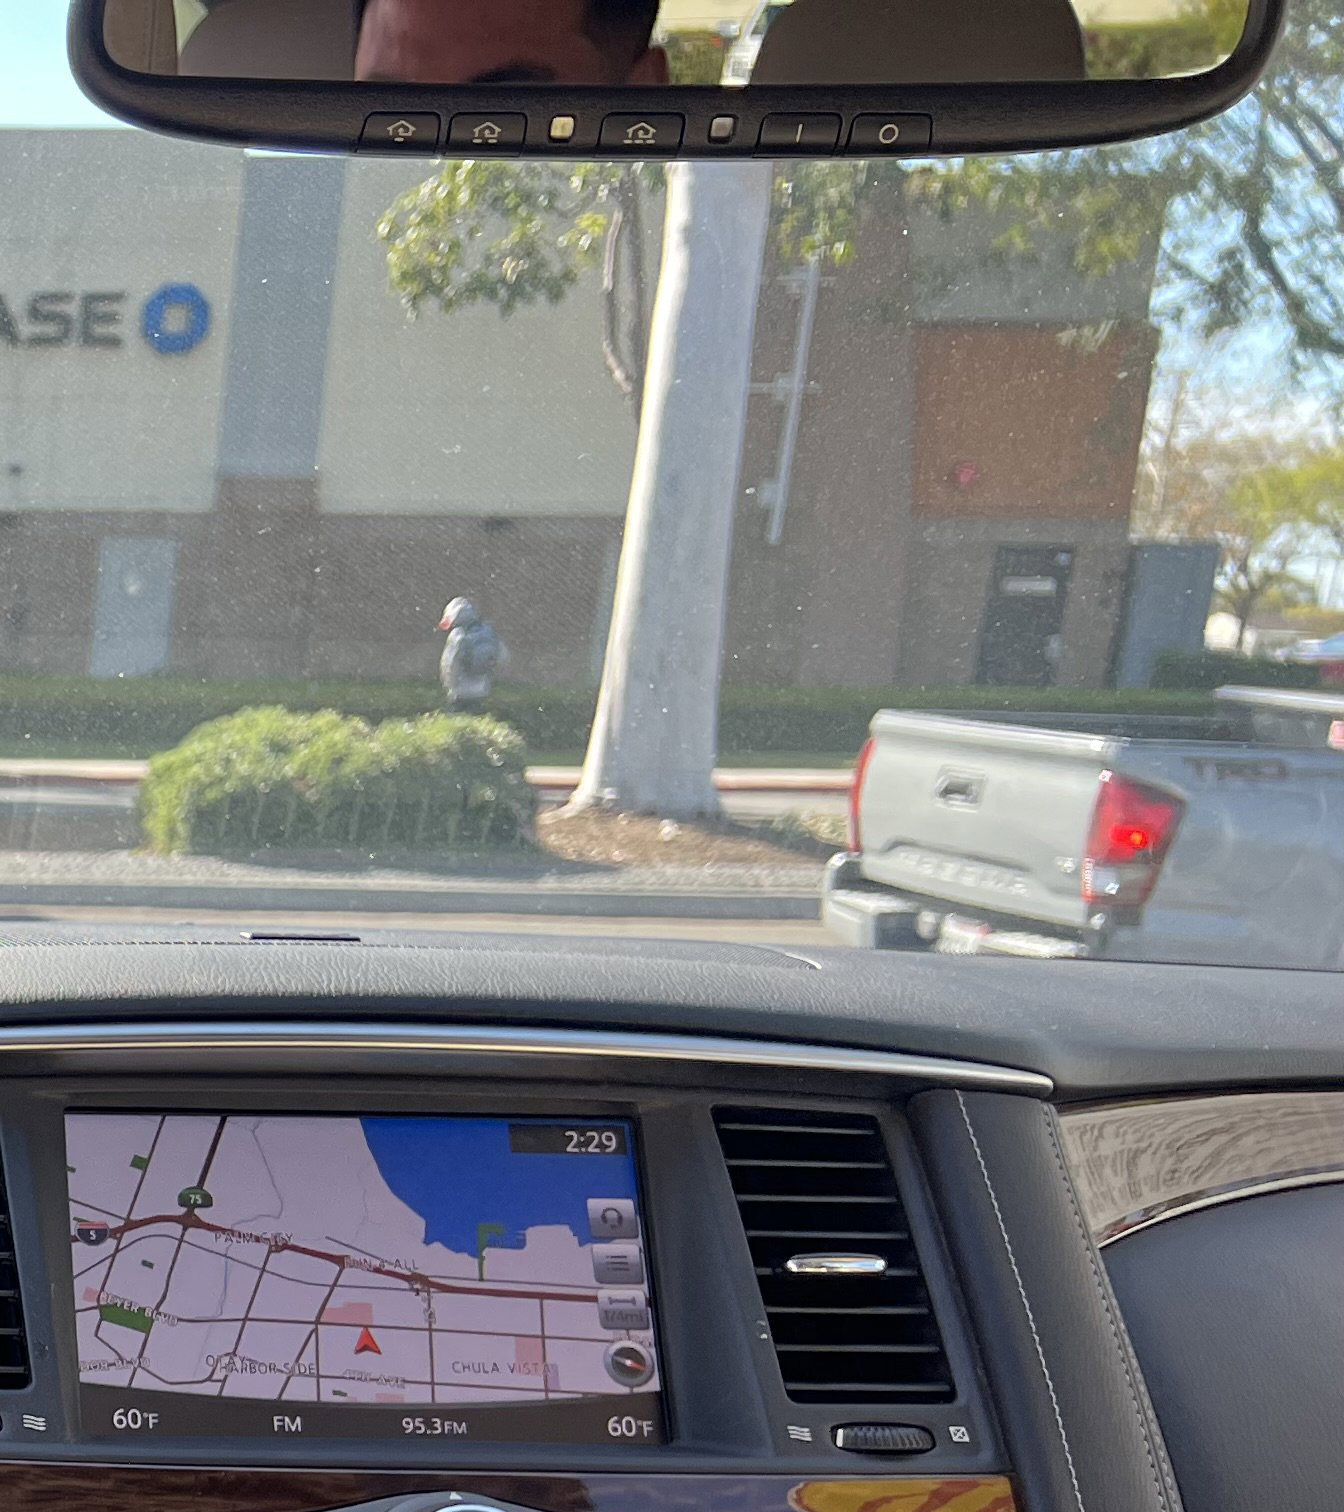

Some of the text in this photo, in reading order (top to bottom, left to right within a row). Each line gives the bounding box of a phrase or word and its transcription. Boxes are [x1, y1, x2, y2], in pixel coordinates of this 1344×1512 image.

[564, 1130, 617, 1154] 2:29
[189, 1195, 202, 1205] 75
[452, 1361, 551, 1375] CHULA VISTA
[273, 1415, 302, 1433] FM
